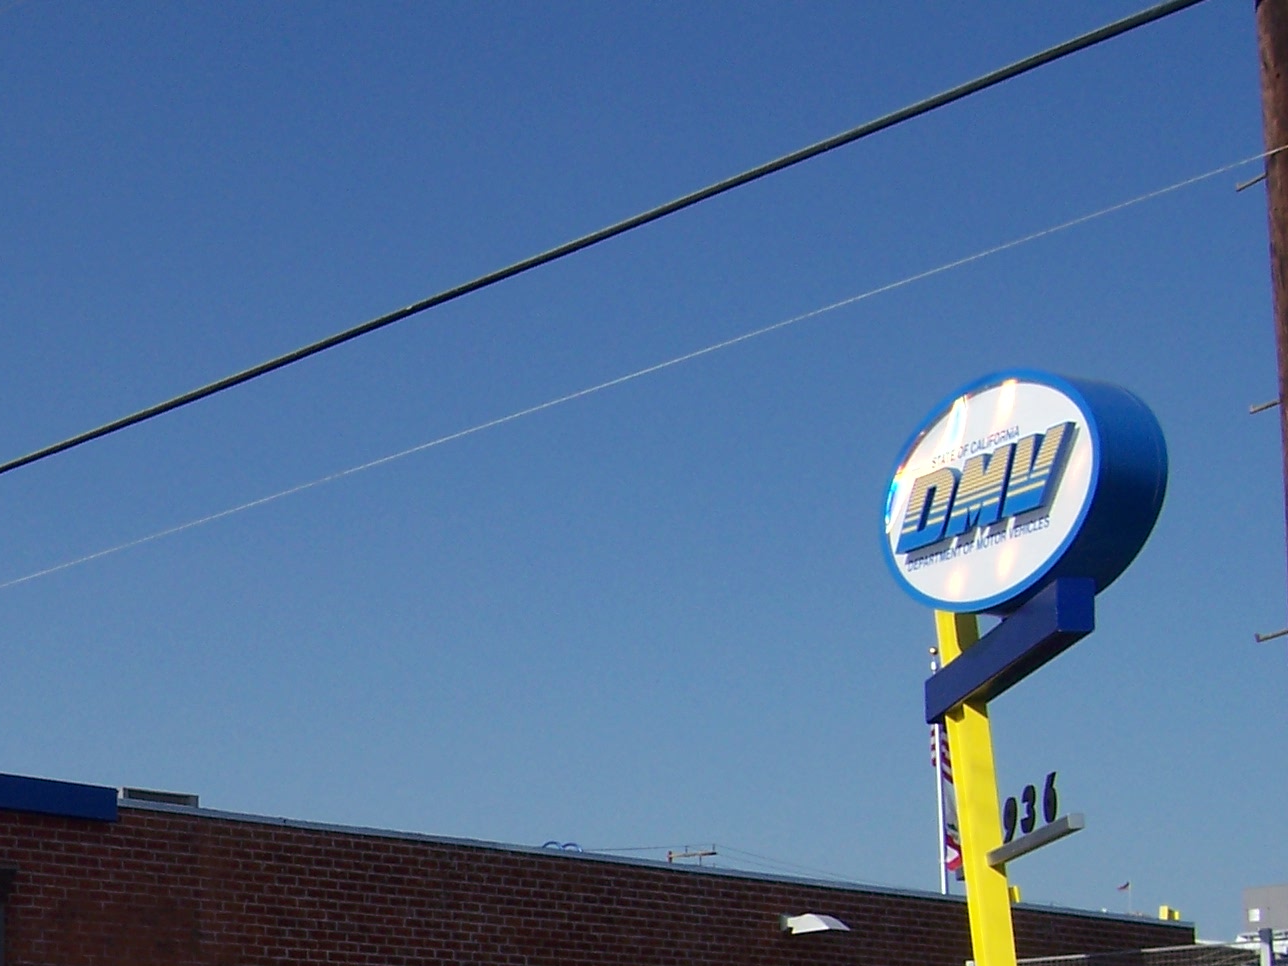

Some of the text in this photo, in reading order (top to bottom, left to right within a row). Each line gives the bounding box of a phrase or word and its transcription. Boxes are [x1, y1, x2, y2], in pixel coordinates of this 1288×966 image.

[957, 443, 970, 459] OF
[970, 425, 1021, 454] CALIFORNIA
[895, 421, 1077, 555] DMV
[907, 515, 1051, 572] DEPARTMENT OF MOTOR VEHICLES
[1002, 771, 1058, 843] 936
